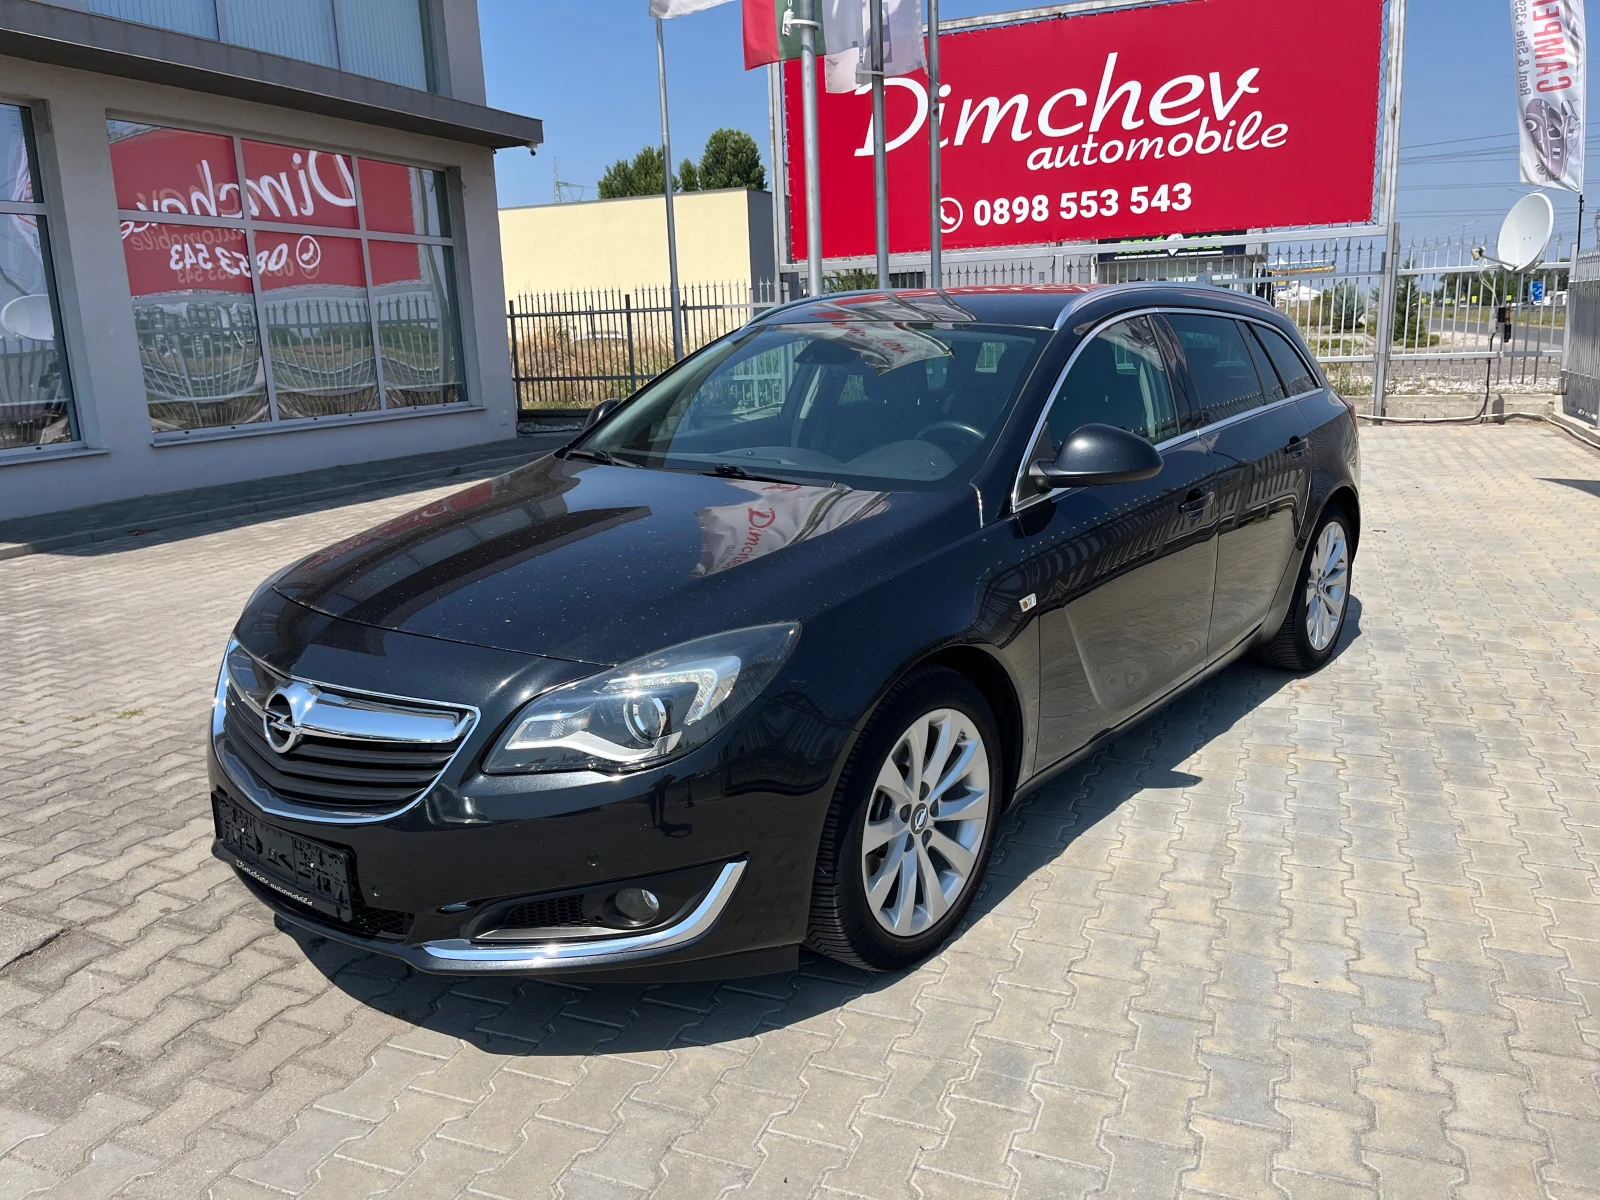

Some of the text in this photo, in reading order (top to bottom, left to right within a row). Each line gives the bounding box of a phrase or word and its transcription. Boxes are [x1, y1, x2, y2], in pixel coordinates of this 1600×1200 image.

[853, 52, 1260, 158] Dimchev
[1025, 111, 1289, 171] automobile
[973, 182, 1192, 227] 0898 553 543
